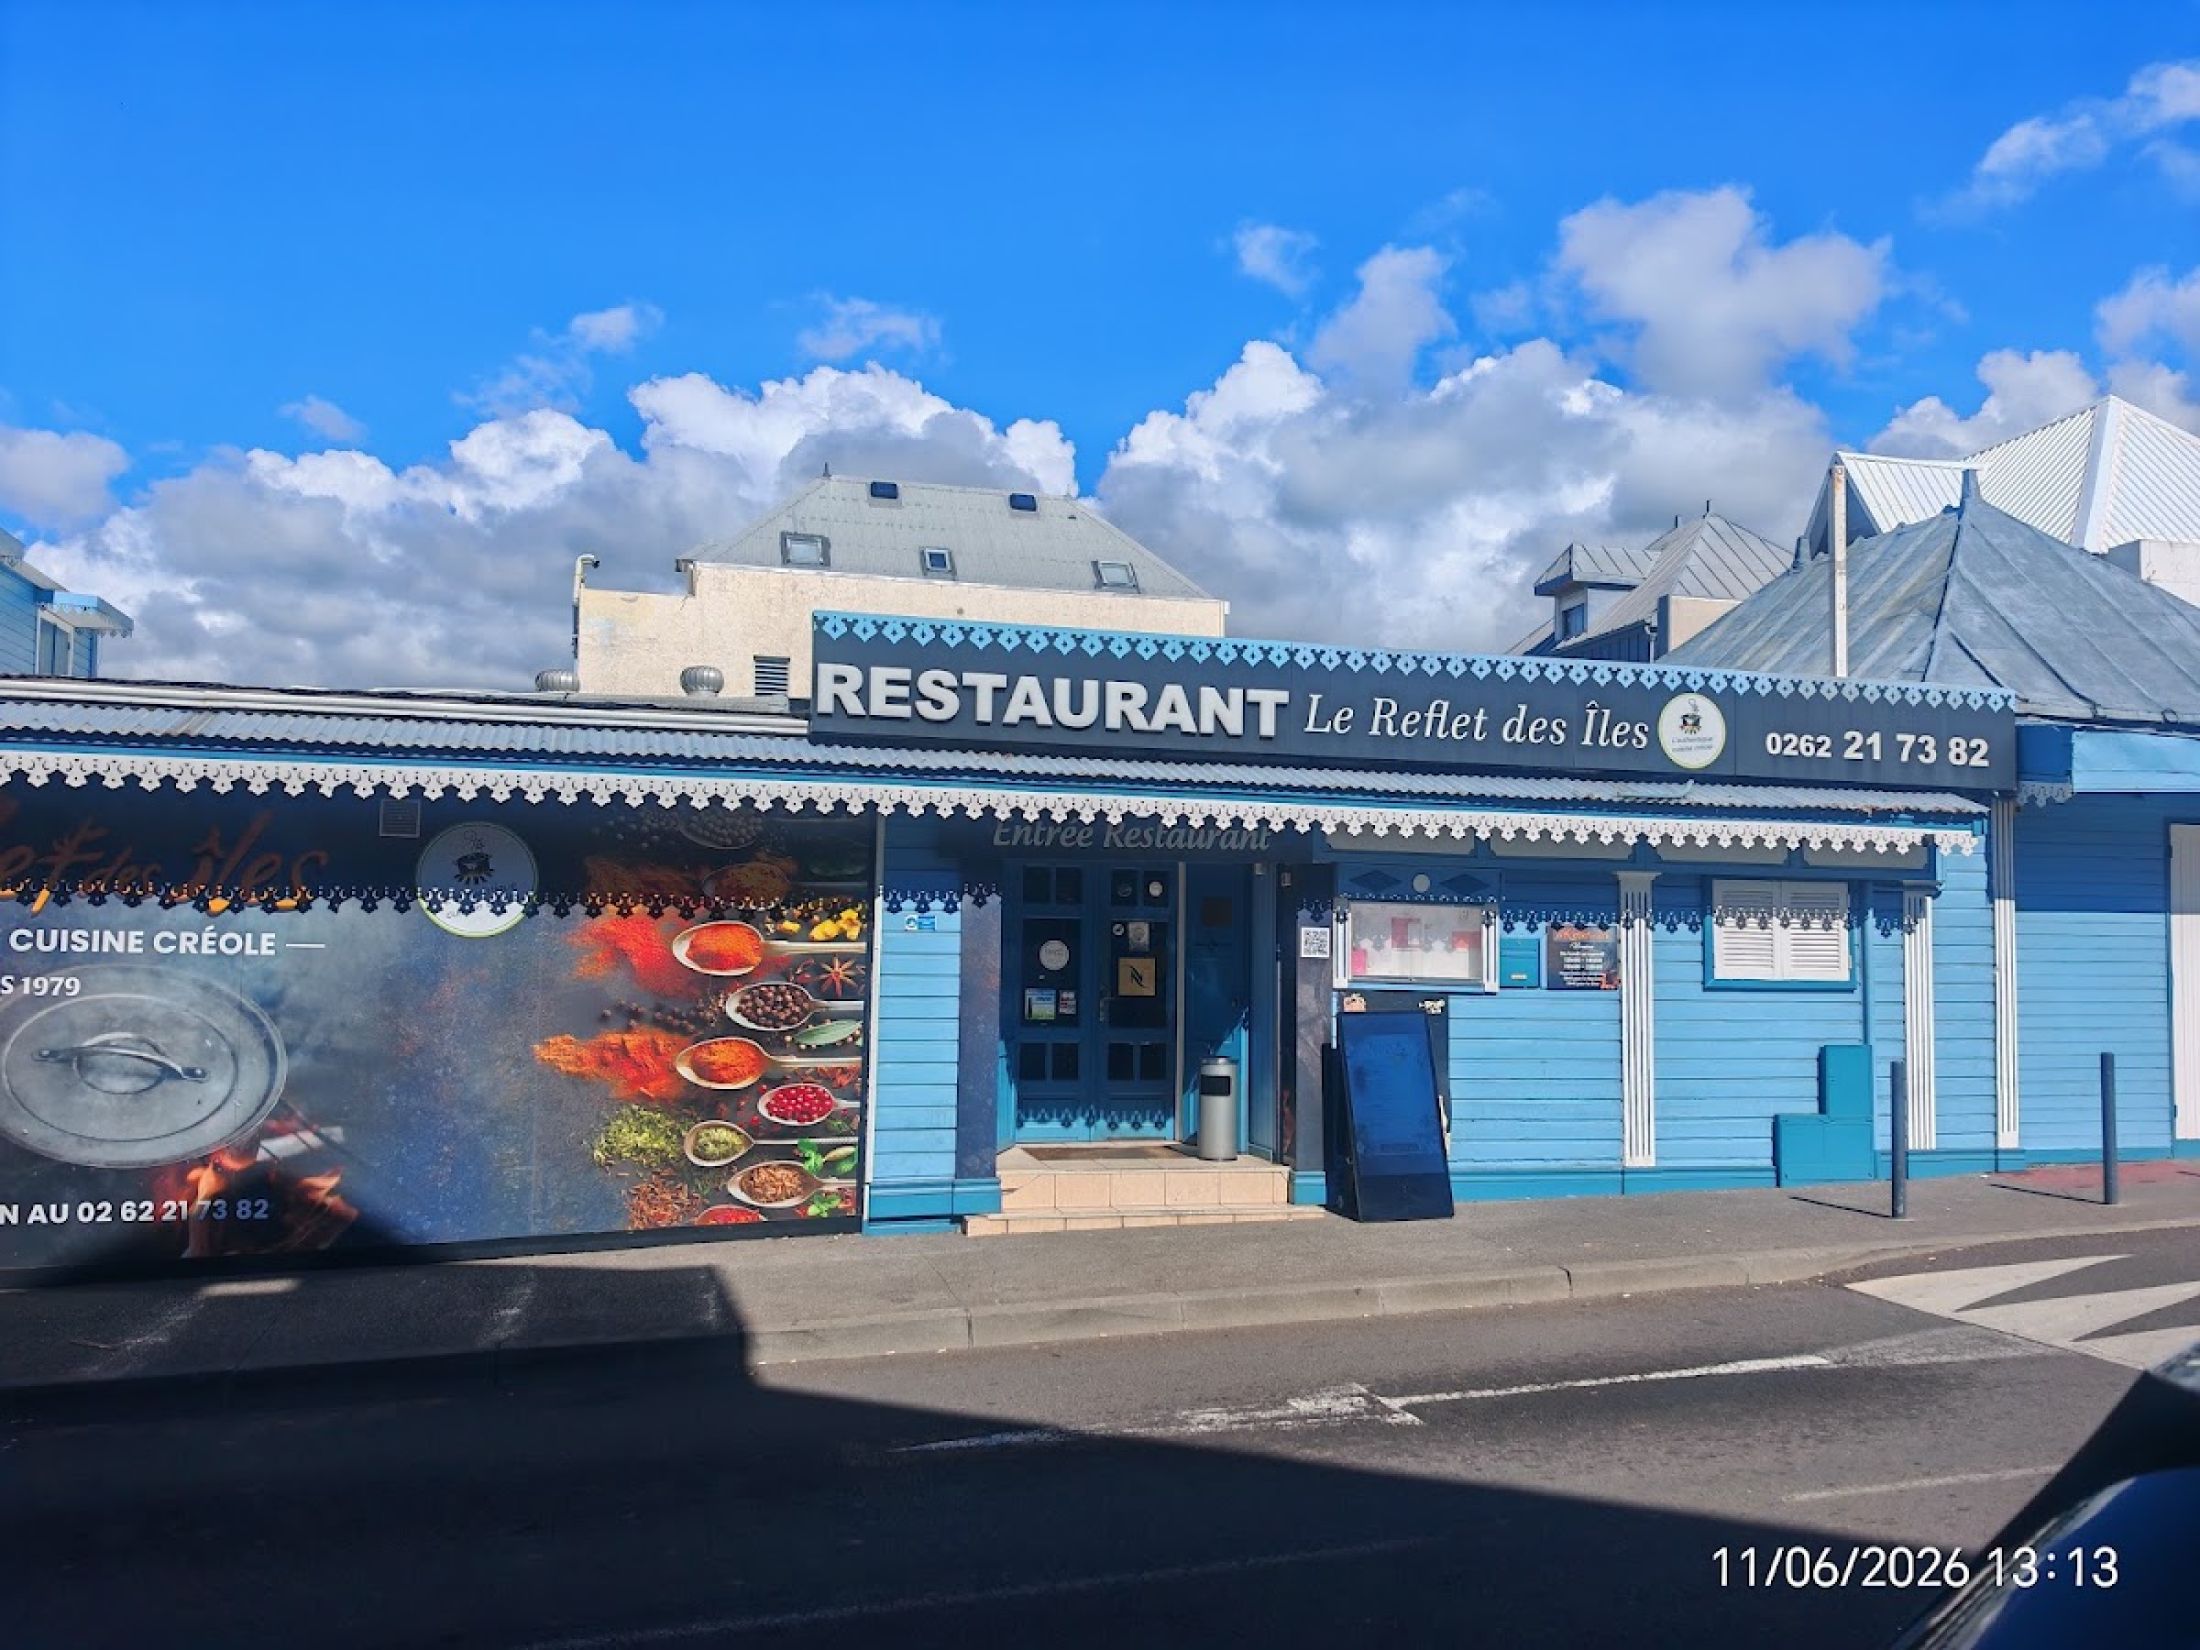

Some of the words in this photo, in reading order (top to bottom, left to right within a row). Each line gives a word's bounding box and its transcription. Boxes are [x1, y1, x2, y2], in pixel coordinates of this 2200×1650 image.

[816, 663, 1290, 738] RESTAURANT
[1304, 694, 1354, 733] Le
[1368, 698, 1489, 741] Reflet
[1502, 704, 1567, 745] des
[1581, 700, 1649, 749] Îles
[1765, 732, 1832, 758] 0262
[1843, 731, 1882, 761] 21
[1896, 733, 1937, 764] 73
[1948, 737, 1990, 767] 82
[993, 818, 1094, 847] Entrée
[1103, 822, 1272, 851] Restaurant
[9, 929, 144, 954] CUISINE
[153, 926, 277, 956] CRÉOLE
[21, 976, 81, 997] 1979
[27, 1204, 69, 1225] AU
[76, 1201, 113, 1223] 02
[120, 1200, 155, 1223] 62
[161, 1200, 189, 1222] 21
[196, 1199, 228, 1221] 73
[236, 1199, 269, 1220] 82
